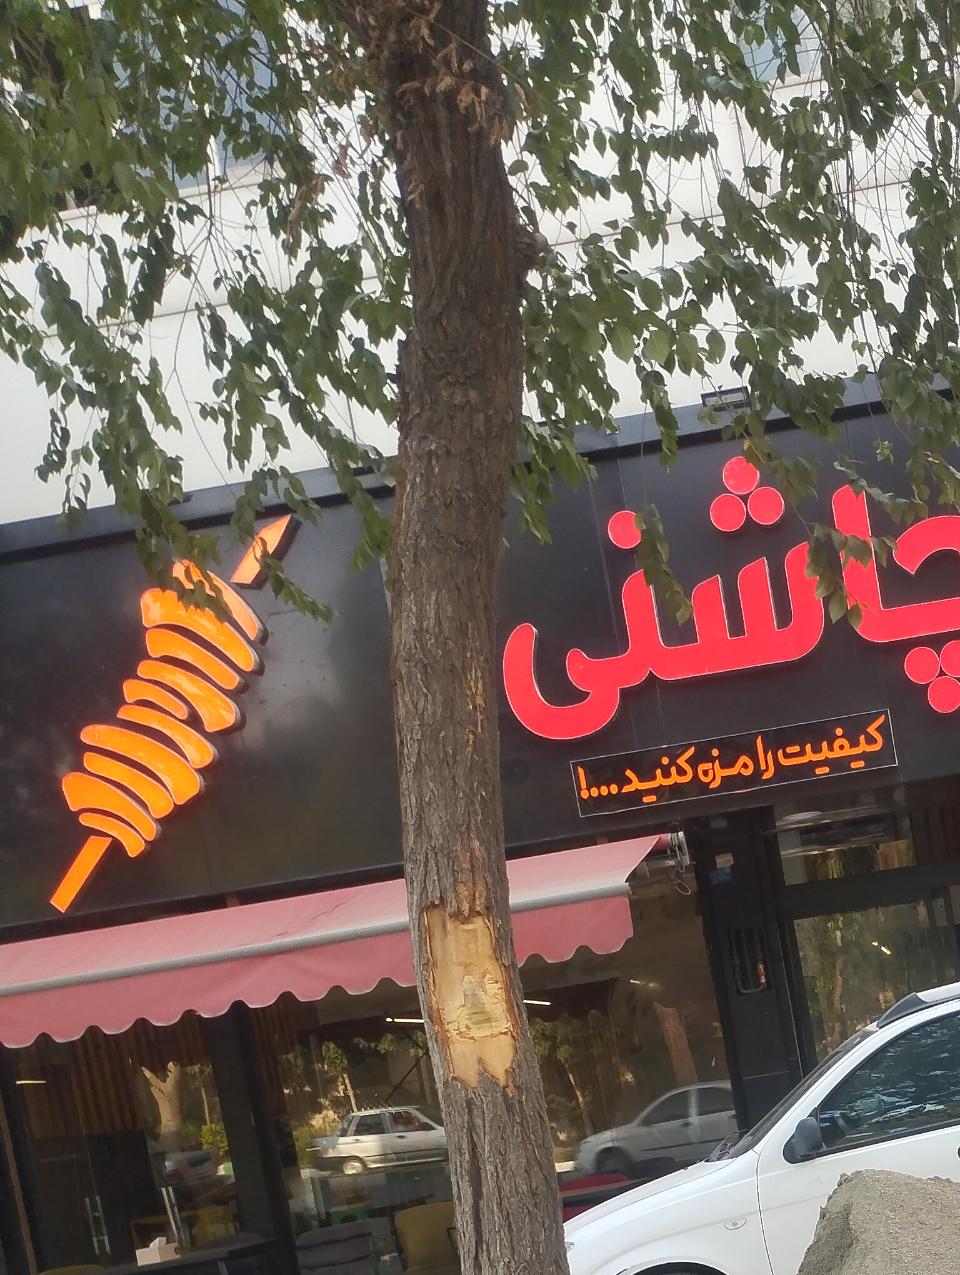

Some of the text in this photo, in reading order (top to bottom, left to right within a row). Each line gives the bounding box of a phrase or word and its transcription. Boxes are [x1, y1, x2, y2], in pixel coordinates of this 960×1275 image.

[756, 735, 775, 780] را
[777, 714, 886, 775] کیفیت
[697, 748, 755, 789] مزه
